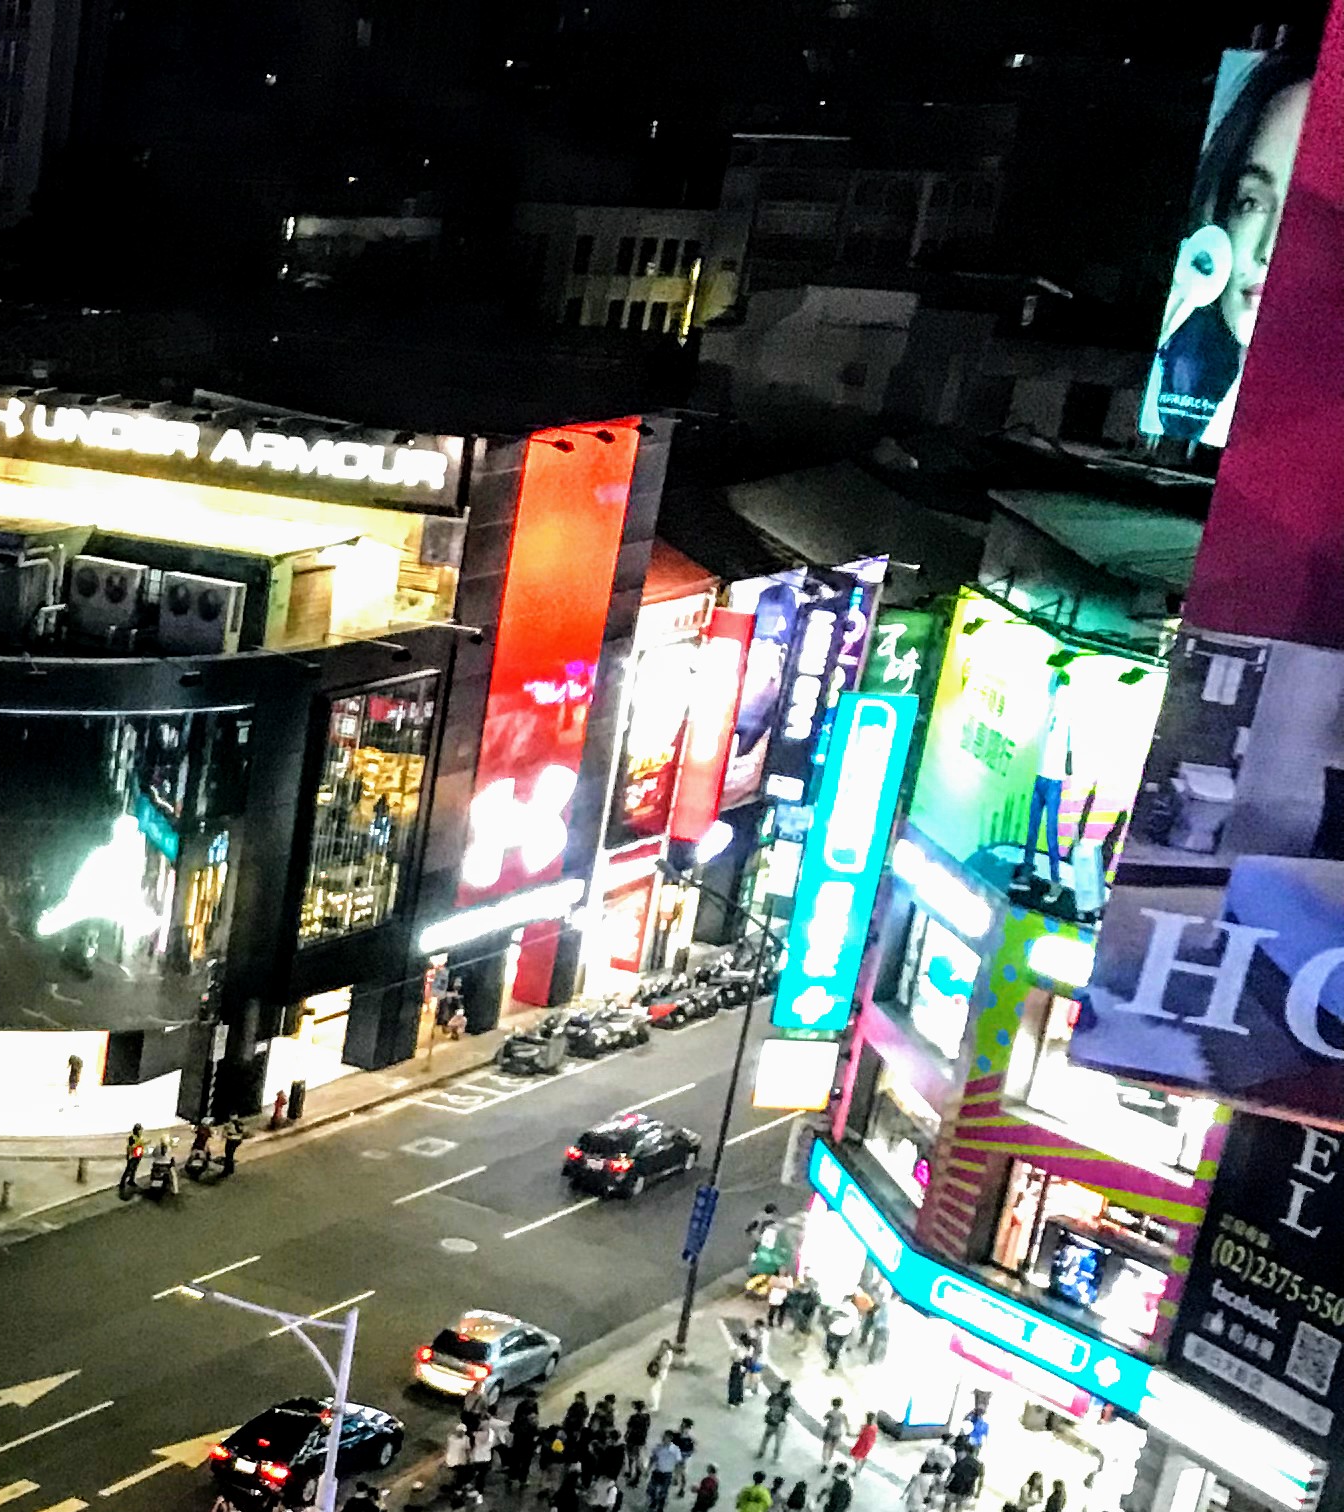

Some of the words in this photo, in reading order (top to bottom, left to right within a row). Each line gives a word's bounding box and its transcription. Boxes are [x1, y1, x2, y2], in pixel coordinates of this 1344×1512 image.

[31, 405, 200, 459] UNDER
[210, 428, 448, 490] ARMOUR
[1212, 1278, 1281, 1331] facebook
